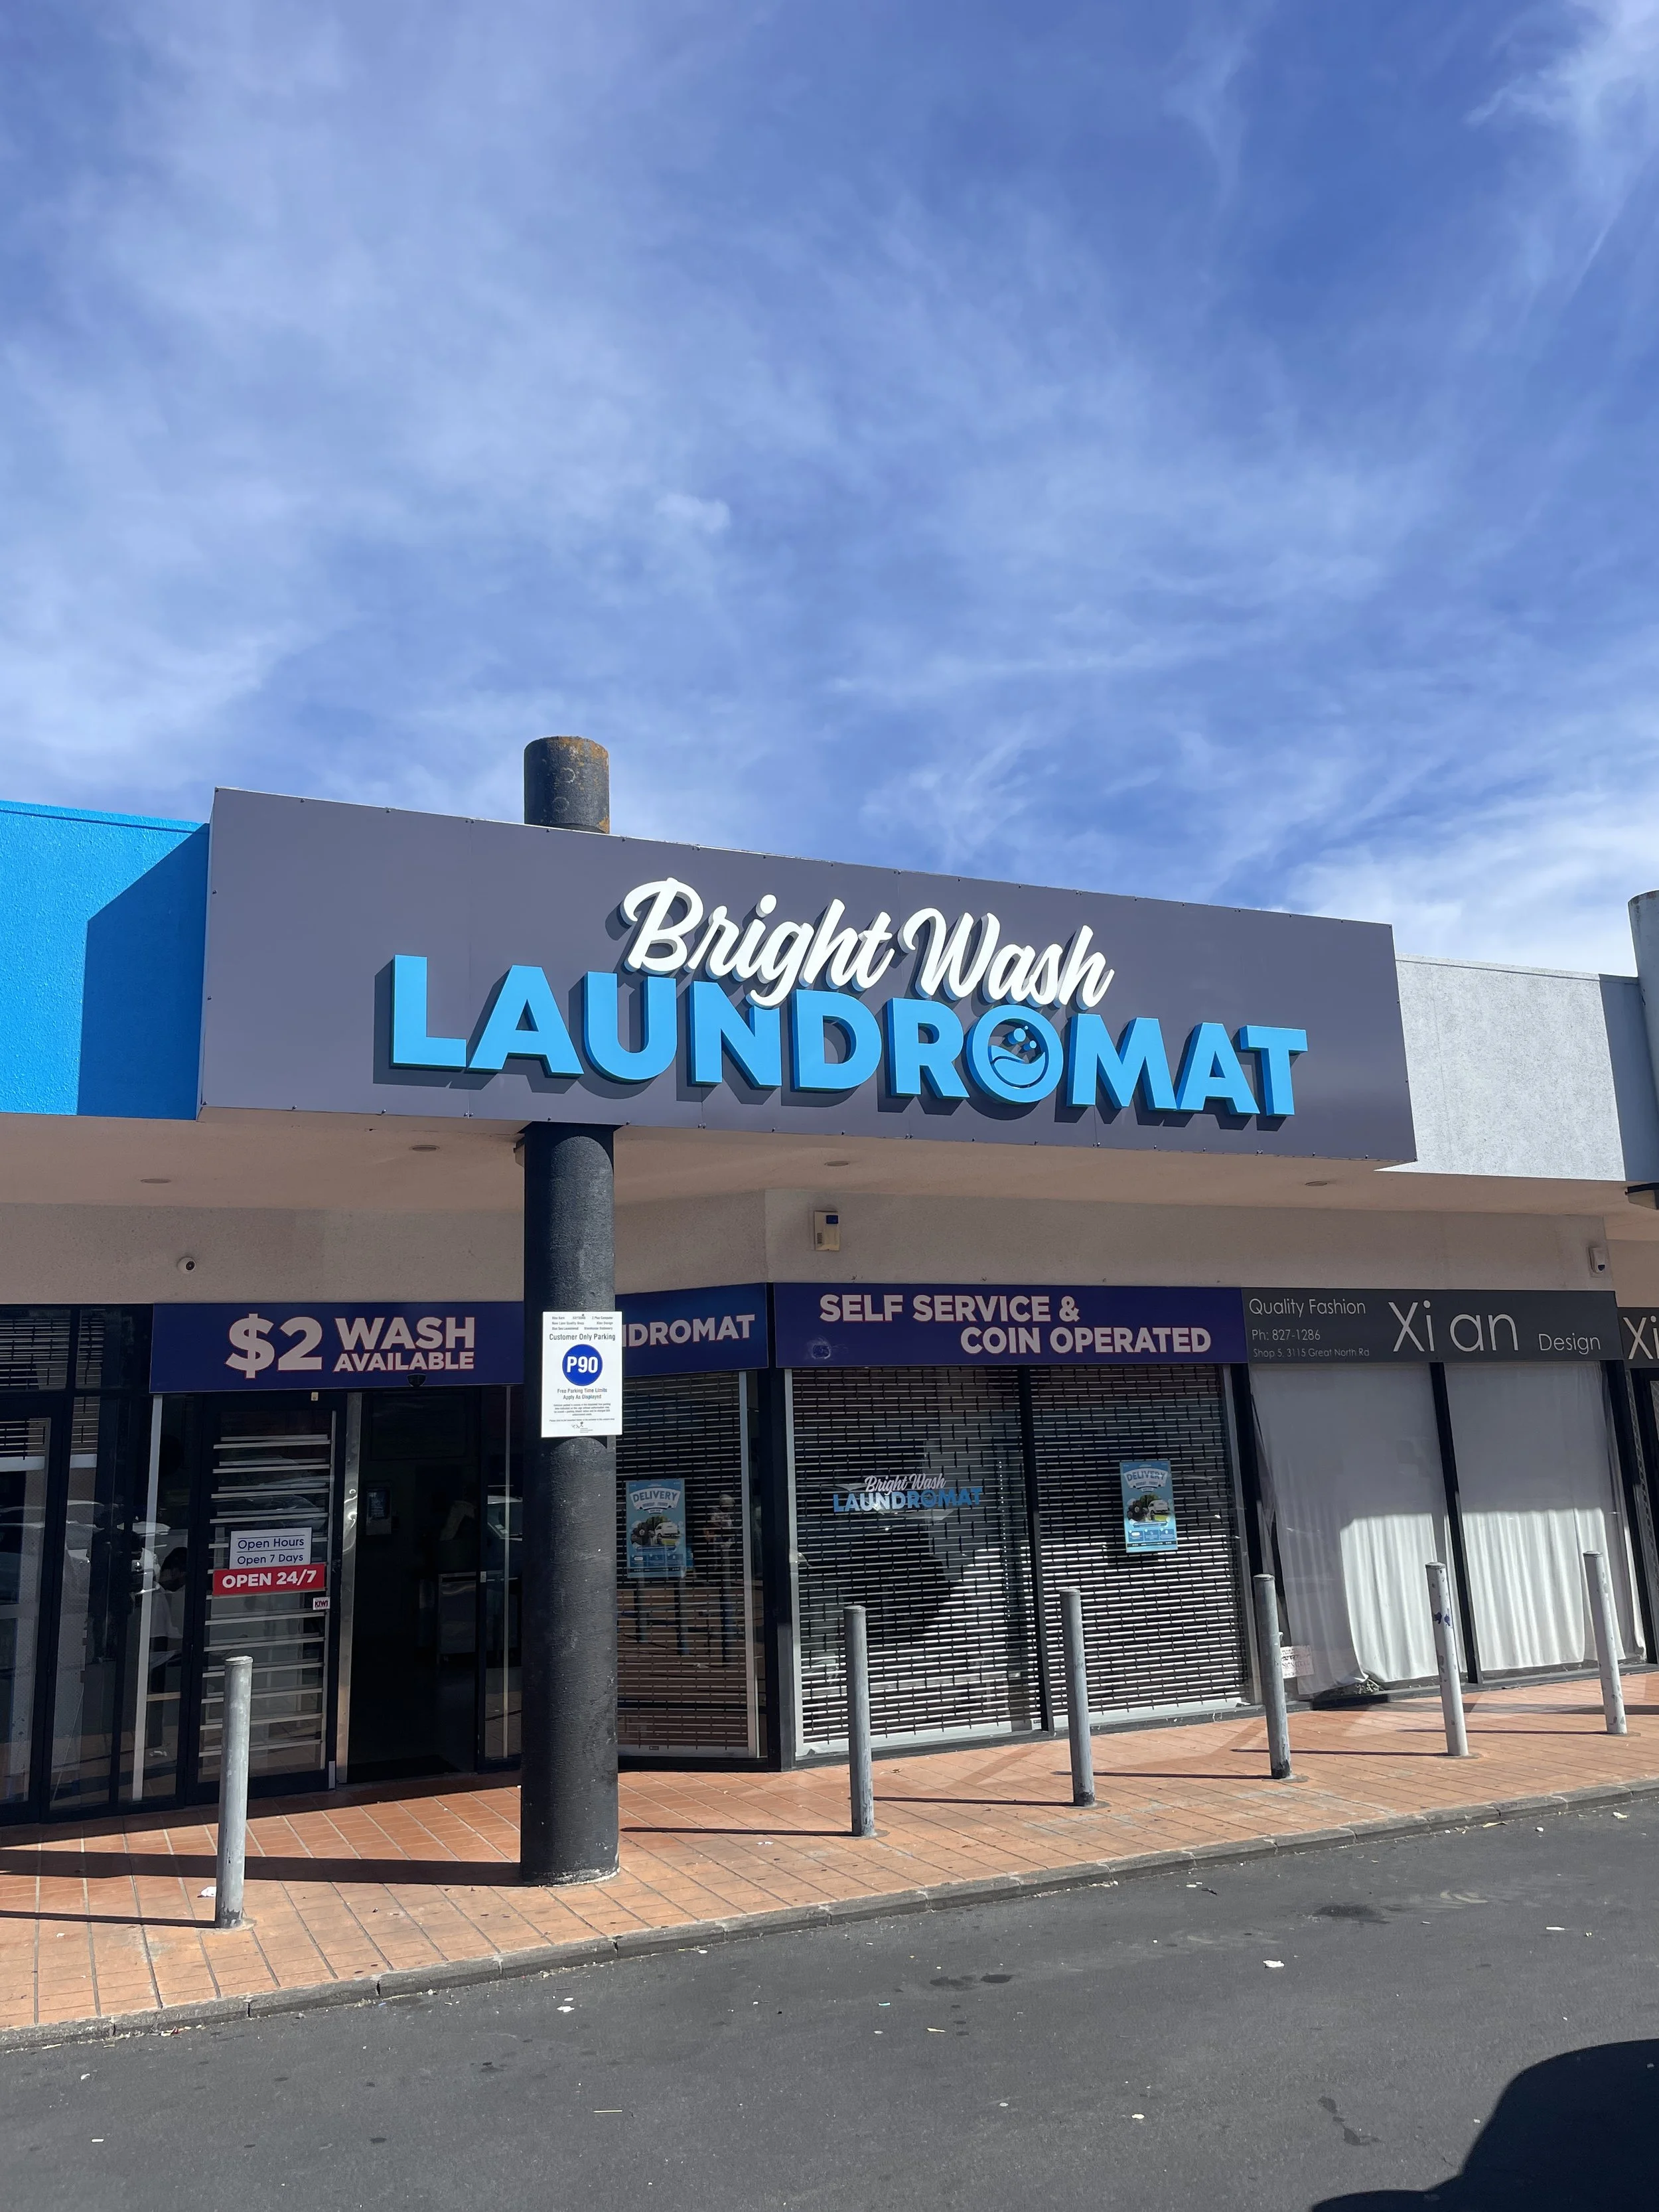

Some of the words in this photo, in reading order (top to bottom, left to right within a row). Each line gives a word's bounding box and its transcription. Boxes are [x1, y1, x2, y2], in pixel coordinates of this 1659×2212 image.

[620, 877, 897, 1008] Bright
[898, 907, 1115, 1010] Wash
[390, 954, 1308, 1116] LAUNDROMAT
[820, 1294, 903, 1322] SELF
[912, 1295, 1051, 1322] SERVICE
[1059, 1296, 1080, 1322] &
[1249, 1298, 1304, 1317] Quality
[1309, 1299, 1366, 1315] Fashion
[960, 1327, 1041, 1354] COIN
[1050, 1327, 1212, 1353] OPERATED
[1252, 1329, 1269, 1341] Ph:
[1272, 1329, 1321, 1341] 827-1286
[1538, 1333, 1601, 1355] Design
[225, 1313, 323, 1379] $2
[334, 1317, 475, 1350] WASH
[1253, 1348, 1275, 1359] Shop
[1287, 1348, 1306, 1358] 3115
[1308, 1348, 1332, 1358] Great
[1334, 1348, 1357, 1357] North
[1358, 1347, 1370, 1357] Rd
[333, 1352, 475, 1372] AVAILABLE
[567, 1356, 598, 1373] P90
[865, 1475, 908, 1495] Bright
[908, 1473, 947, 1489] Wash
[1127, 1470, 1165, 1481] DELIVERY
[633, 1491, 678, 1503] DELIVERY
[833, 1487, 983, 1512] LAUNDROMAT
[238, 1539, 269, 1550] Open
[273, 1538, 304, 1548] Hours
[237, 1556, 266, 1566] Open
[279, 1554, 303, 1563] Days
[222, 1573, 272, 1588] OPEN
[276, 1569, 317, 1585] 24/7
